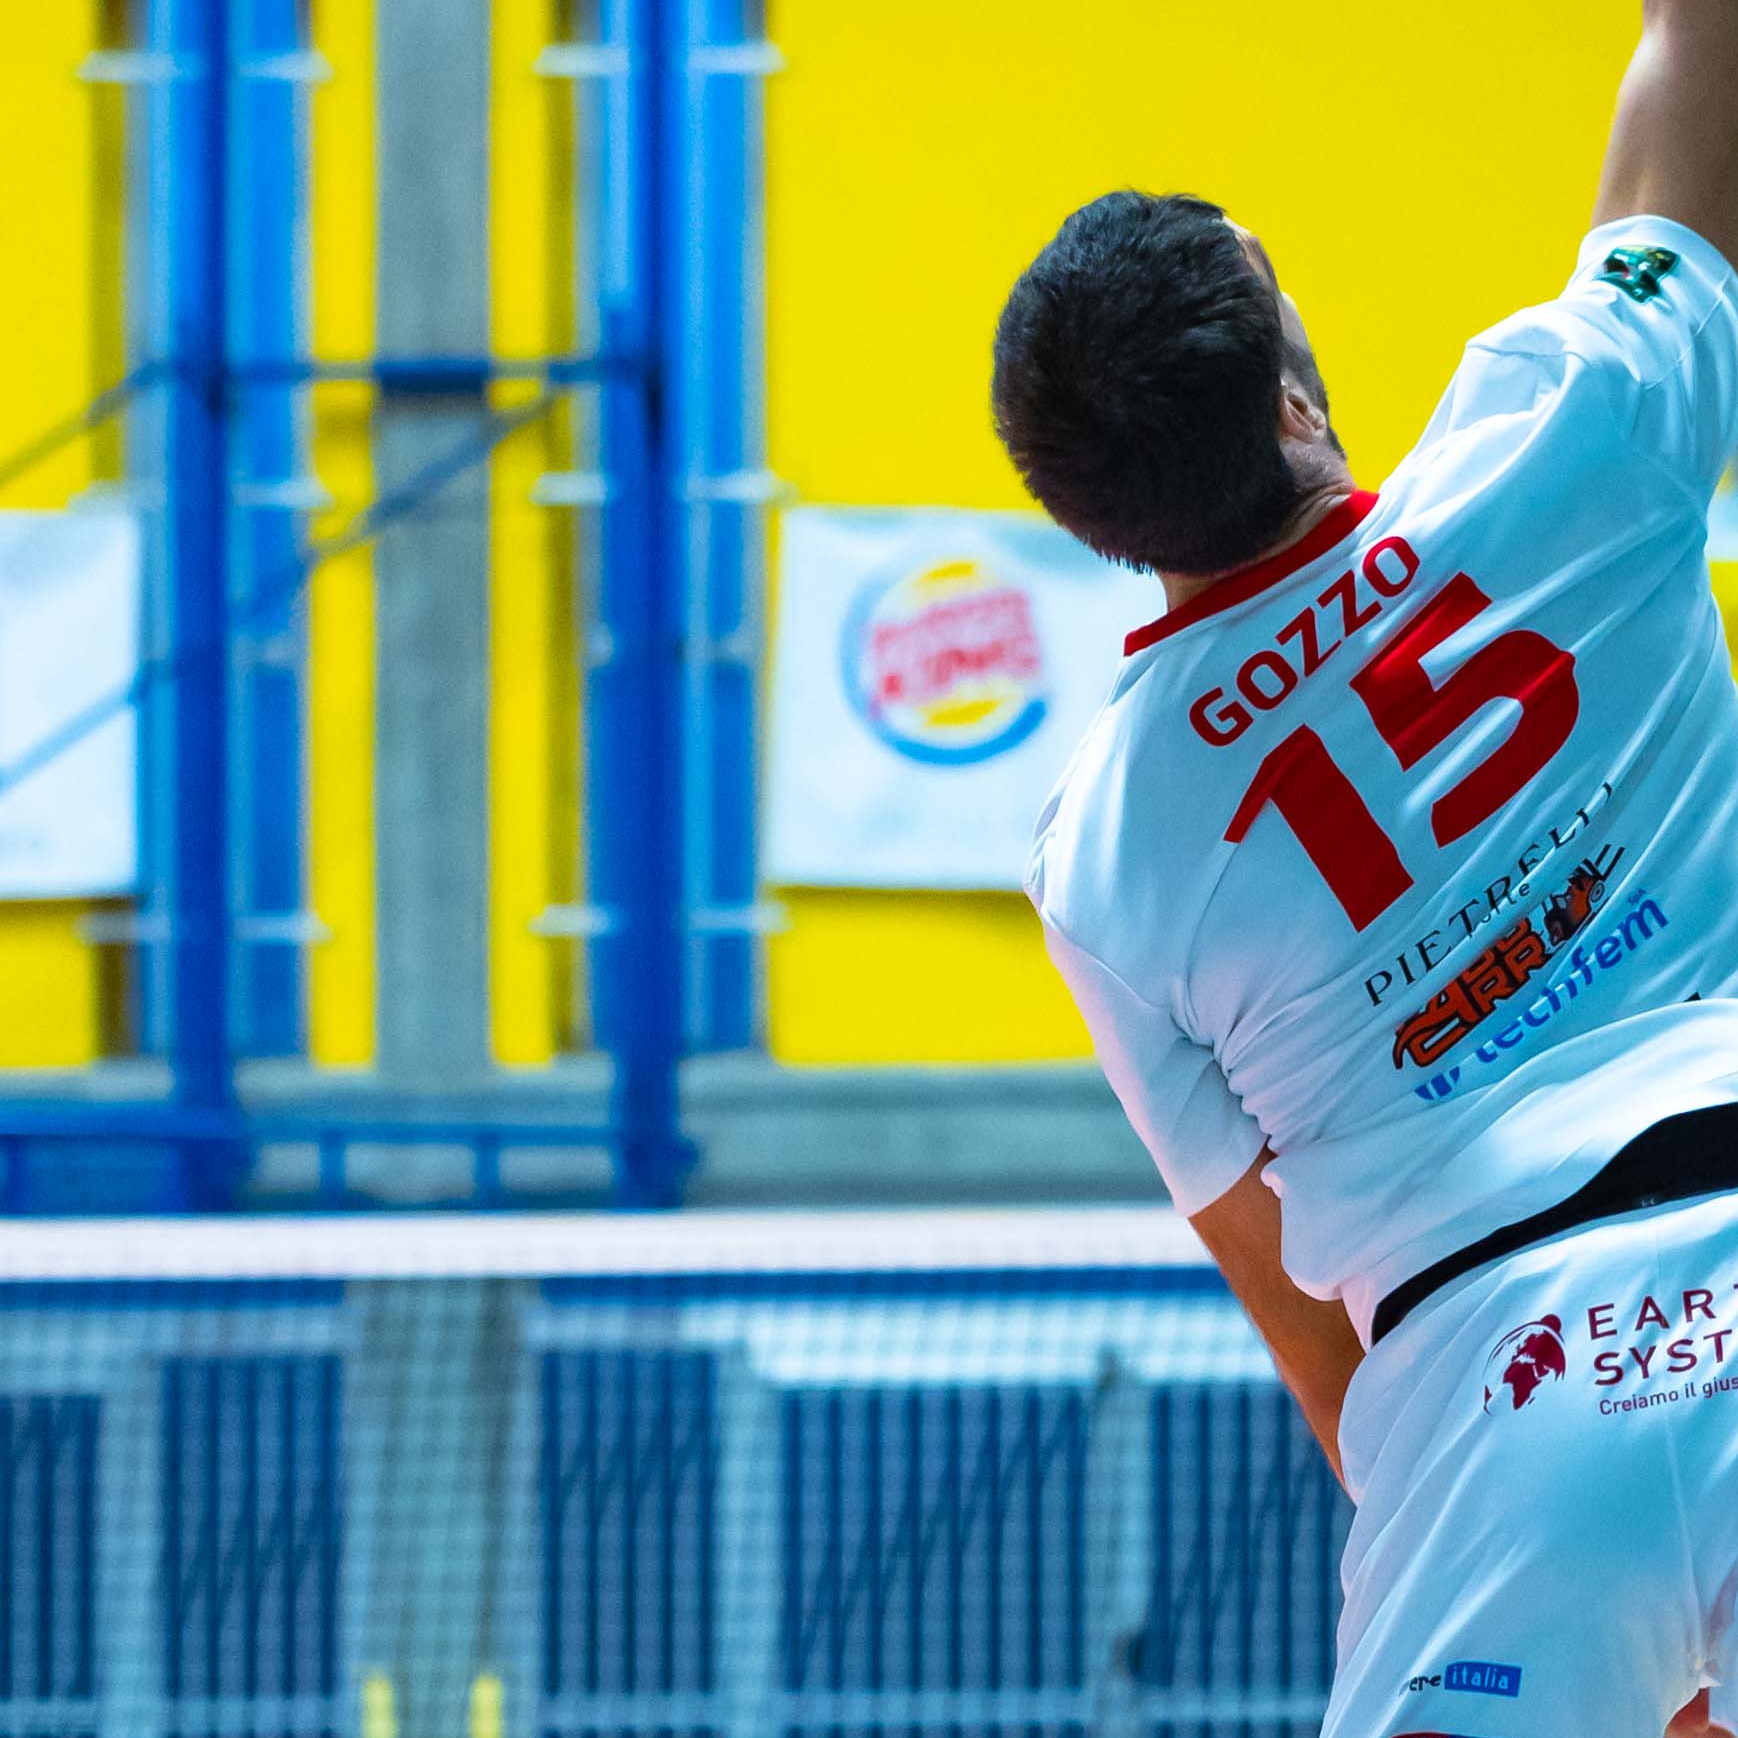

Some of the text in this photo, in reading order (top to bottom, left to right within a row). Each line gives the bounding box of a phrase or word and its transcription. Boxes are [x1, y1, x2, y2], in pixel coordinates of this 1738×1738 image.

[1188, 535, 1421, 749] GOZZO
[1224, 571, 1580, 934] 15
[1599, 1388, 1679, 1415] Creiamo
[1685, 1382, 1697, 1399] il
[1452, 1666, 1510, 1690] italia
